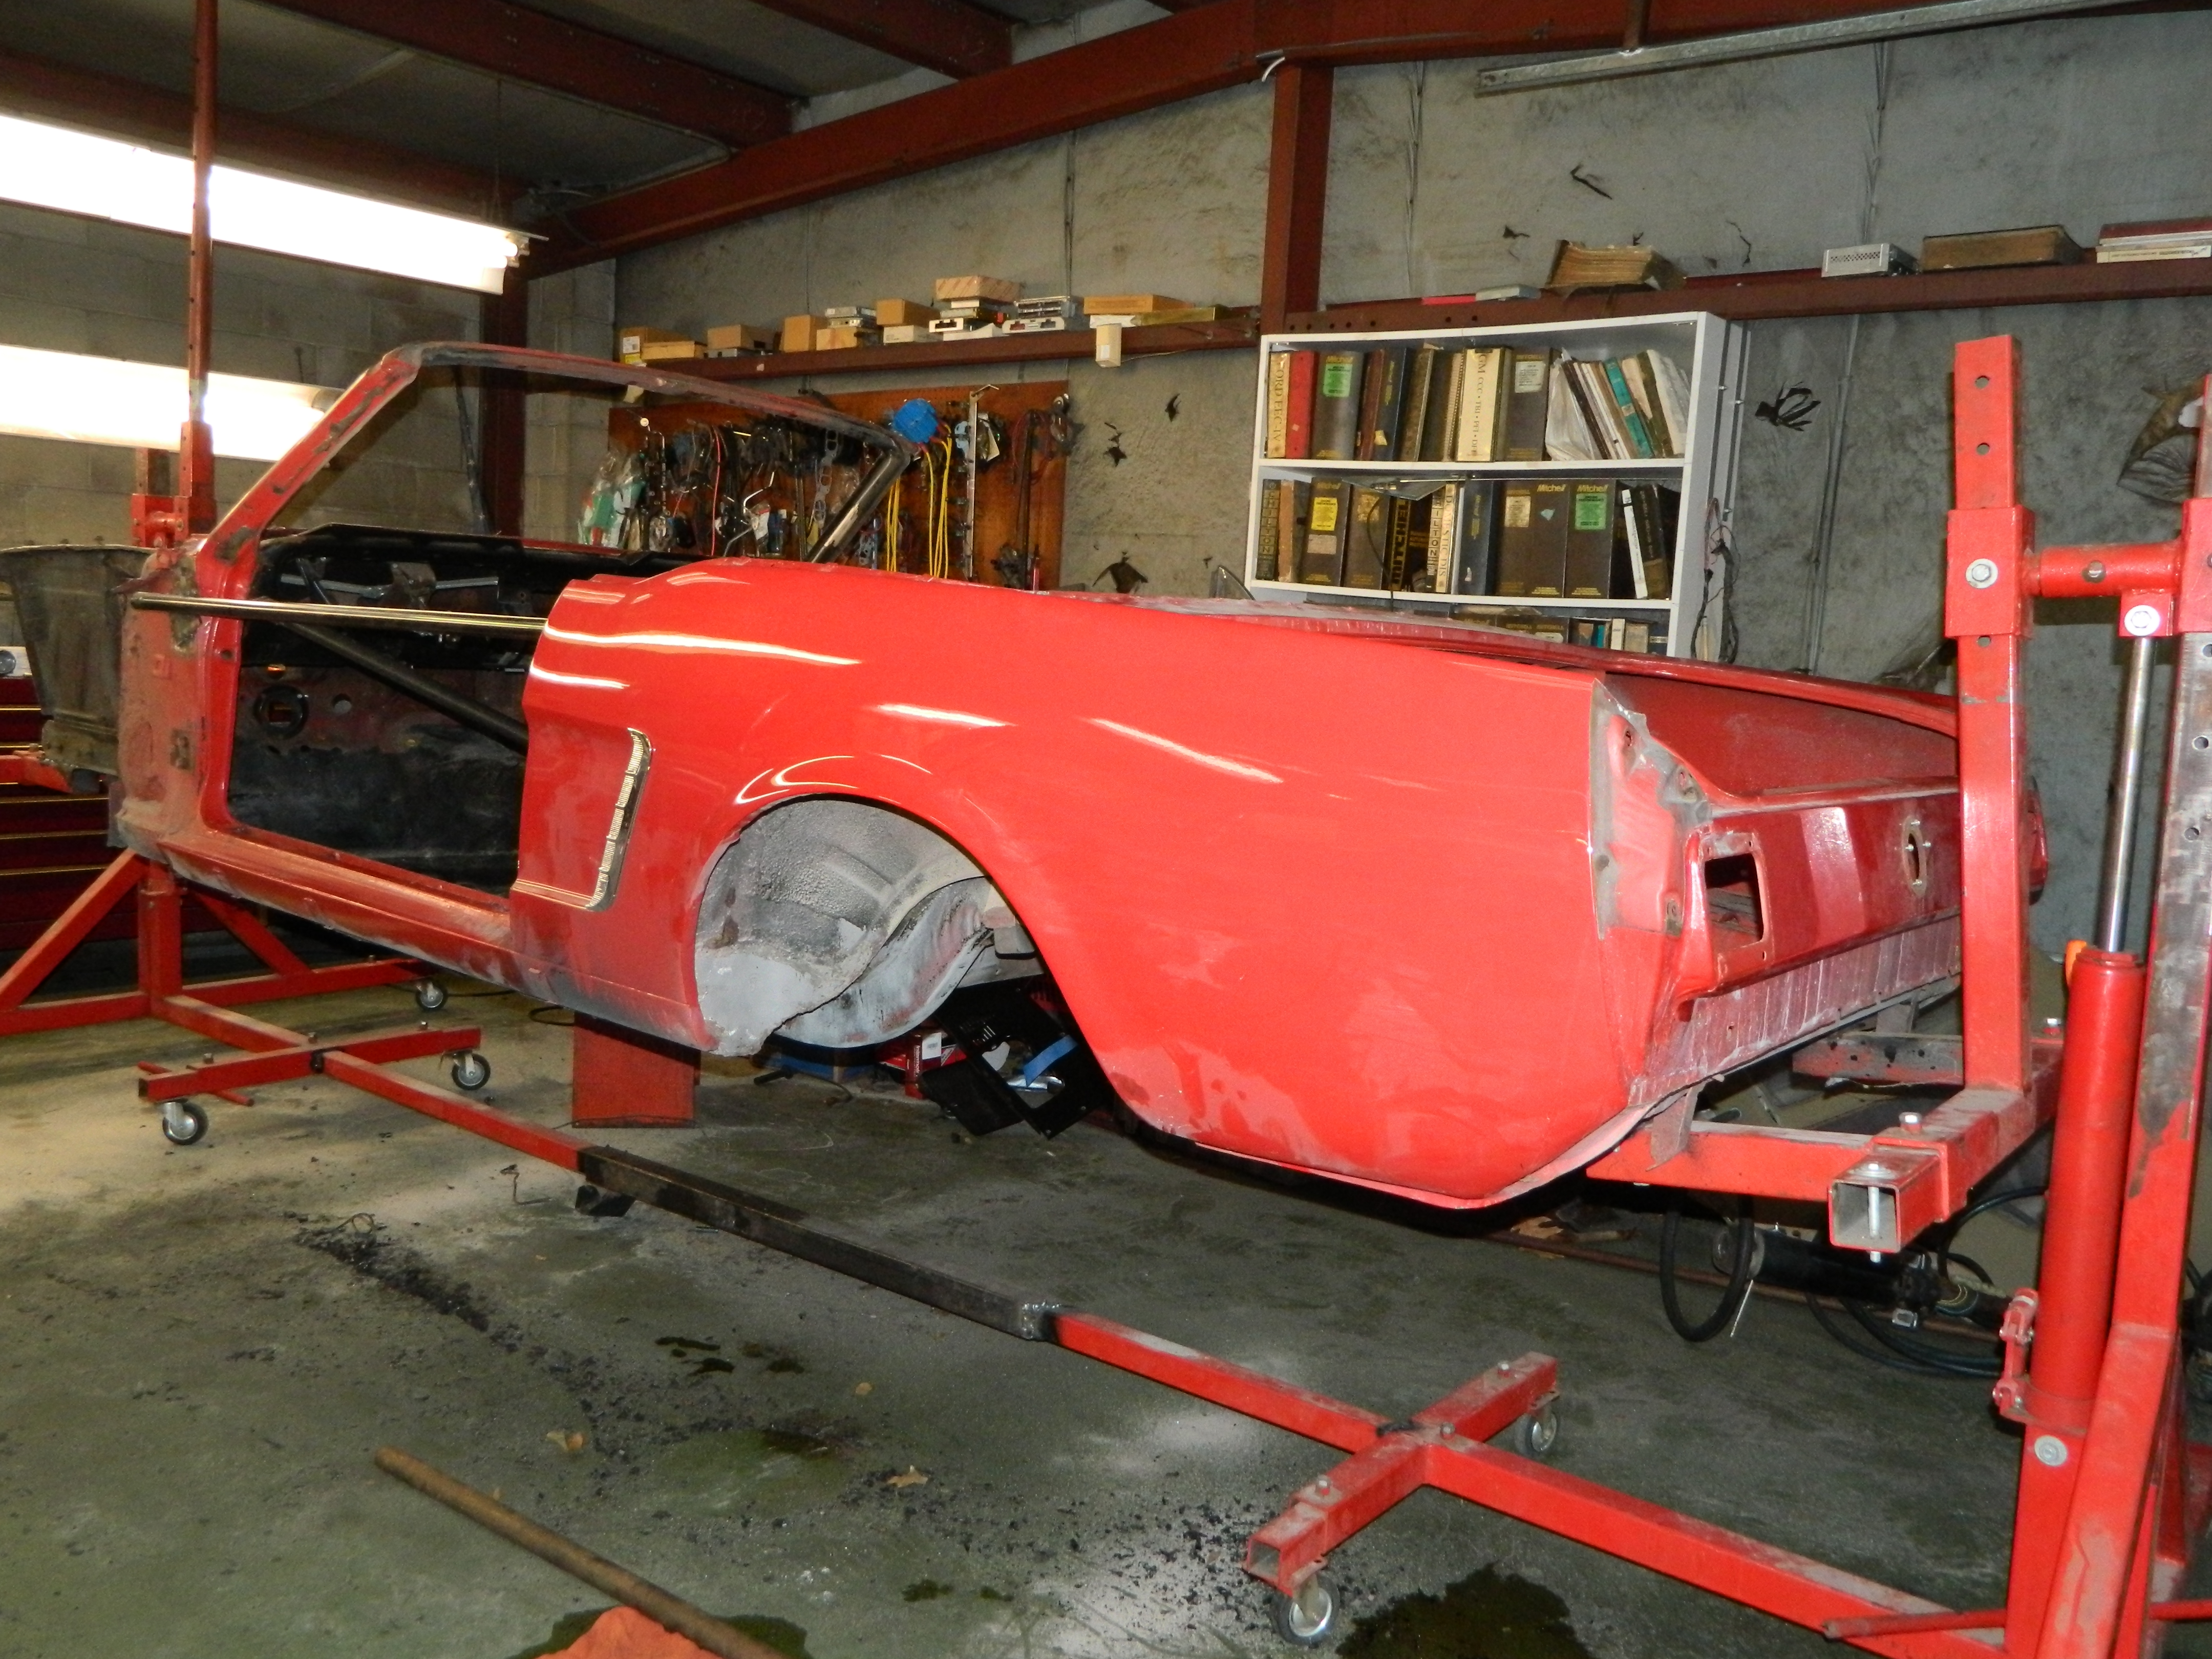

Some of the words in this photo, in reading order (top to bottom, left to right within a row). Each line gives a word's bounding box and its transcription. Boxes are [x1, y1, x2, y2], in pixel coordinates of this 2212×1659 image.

[1477, 377, 1485, 394] CCC
[1478, 354, 1486, 373] GM
[1273, 401, 1283, 441] EEC-IV
[1263, 492, 1277, 552] CHILTON
[1391, 500, 1408, 584] MITCHEL
[1430, 492, 1442, 556] HILTON
[1441, 495, 1453, 555] DOMESTIC
[1438, 558, 1447, 576] DIS
